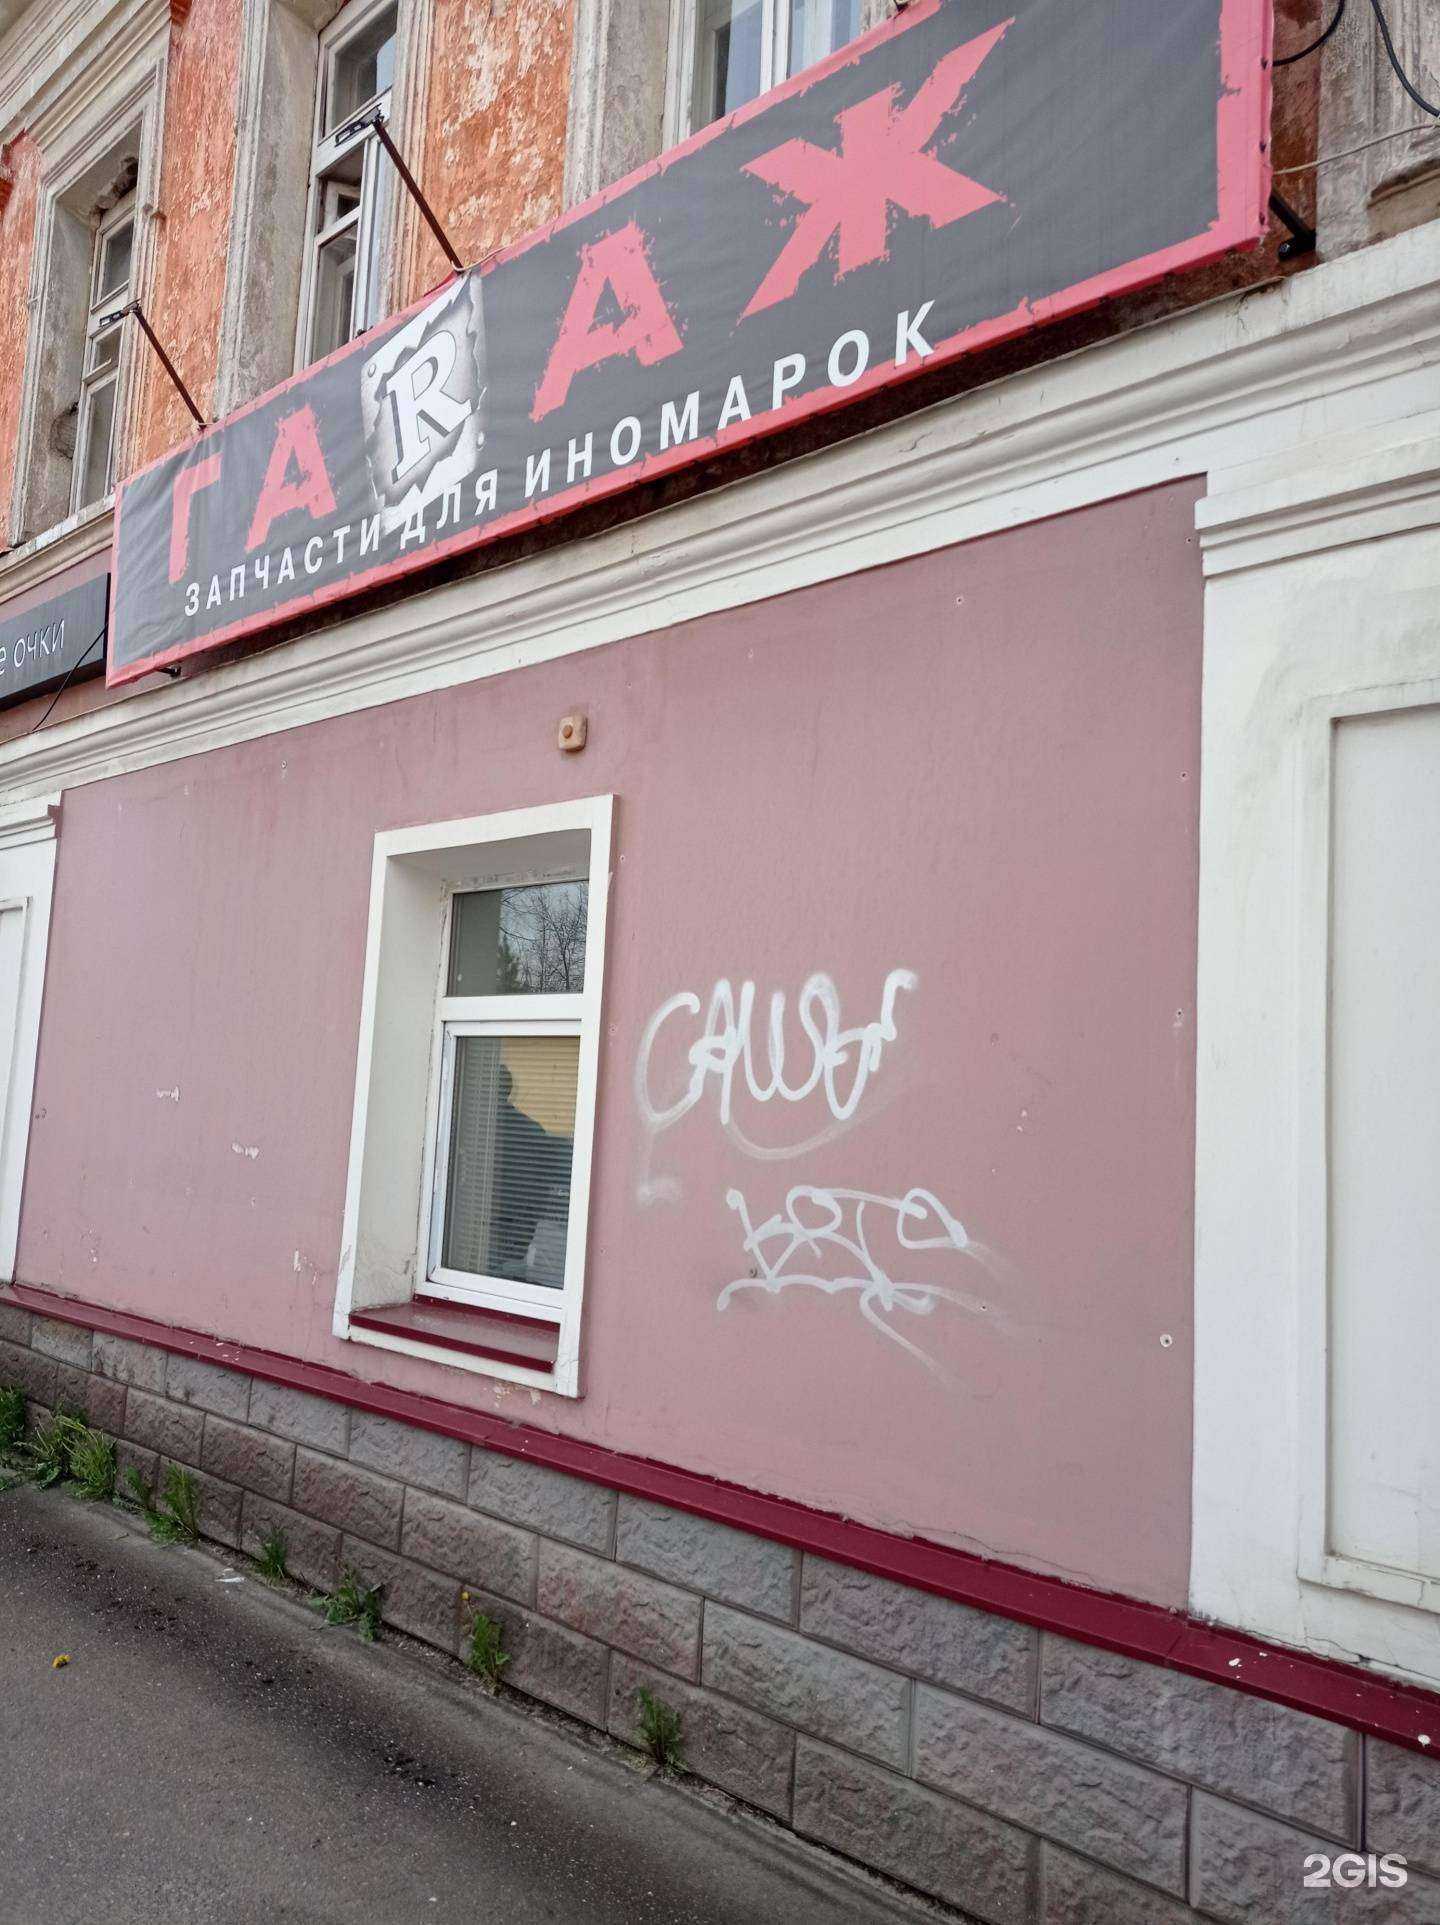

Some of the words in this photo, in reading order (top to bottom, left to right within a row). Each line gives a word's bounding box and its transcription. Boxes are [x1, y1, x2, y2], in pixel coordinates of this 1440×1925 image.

[184, 513, 381, 617] ЗАПЧАСТИ
[399, 468, 498, 550] ДЛЯ
[523, 299, 936, 498] ИНОМАРОК
